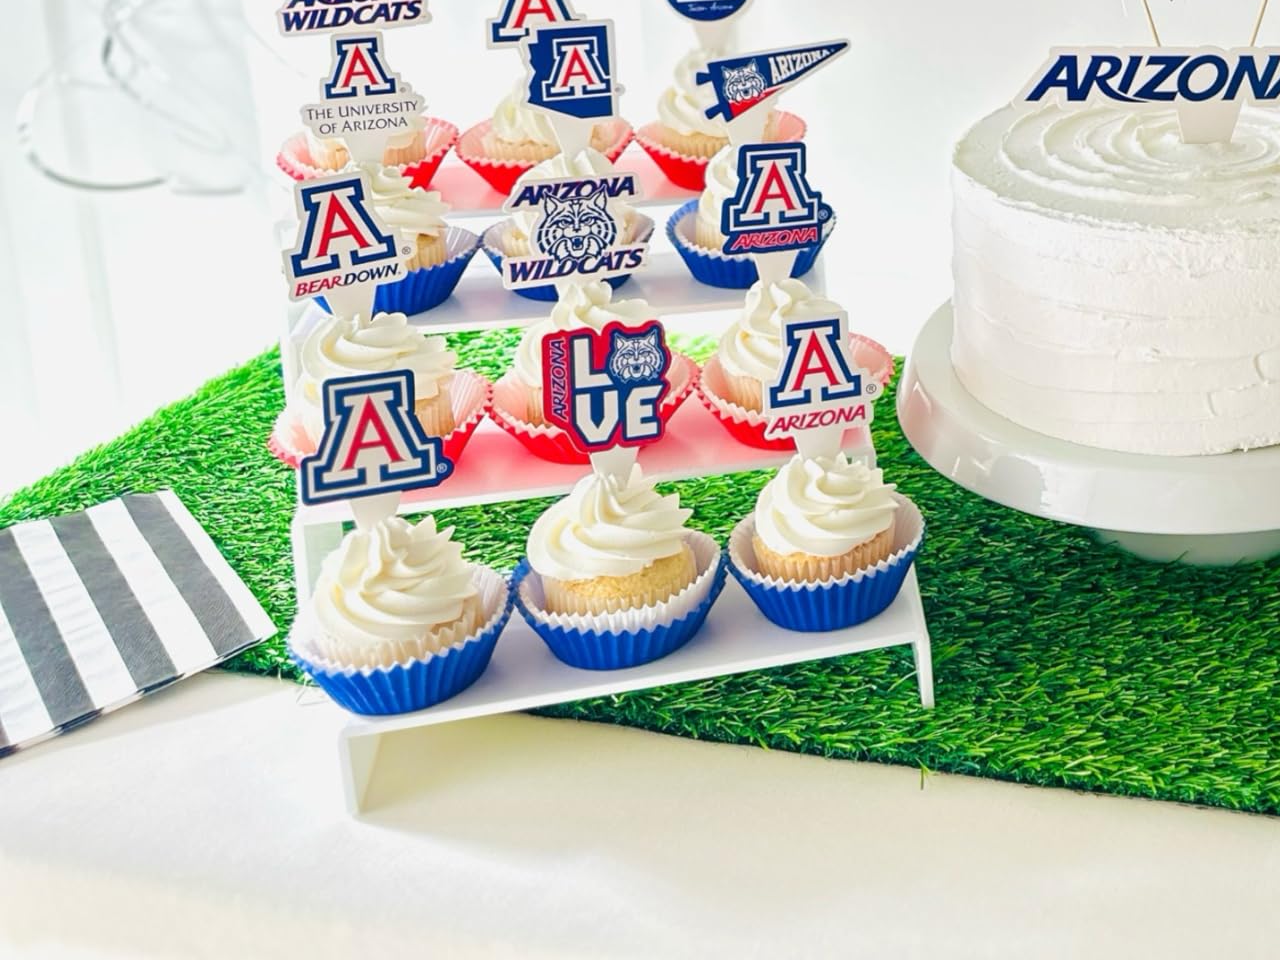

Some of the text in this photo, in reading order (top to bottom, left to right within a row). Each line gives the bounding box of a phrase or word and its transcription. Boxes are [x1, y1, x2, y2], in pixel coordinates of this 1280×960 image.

[281, 0, 423, 32] WILDCATS
[324, 37, 396, 99] A
[542, 36, 611, 102] A
[768, 49, 831, 85] ARIZONA
[307, 100, 419, 120] THE UNIVERSITY
[319, 117, 408, 135] OF ARIZONA
[511, 175, 636, 208] ARIZONA
[729, 147, 819, 229] A
[290, 178, 397, 278] A
[730, 227, 819, 251] ARIZONA
[509, 247, 645, 284] WILDCATS
[553, 337, 568, 423] ARIZONA
[770, 318, 863, 408] A
[304, 373, 441, 503] A
[769, 405, 867, 436] ARIZONA
